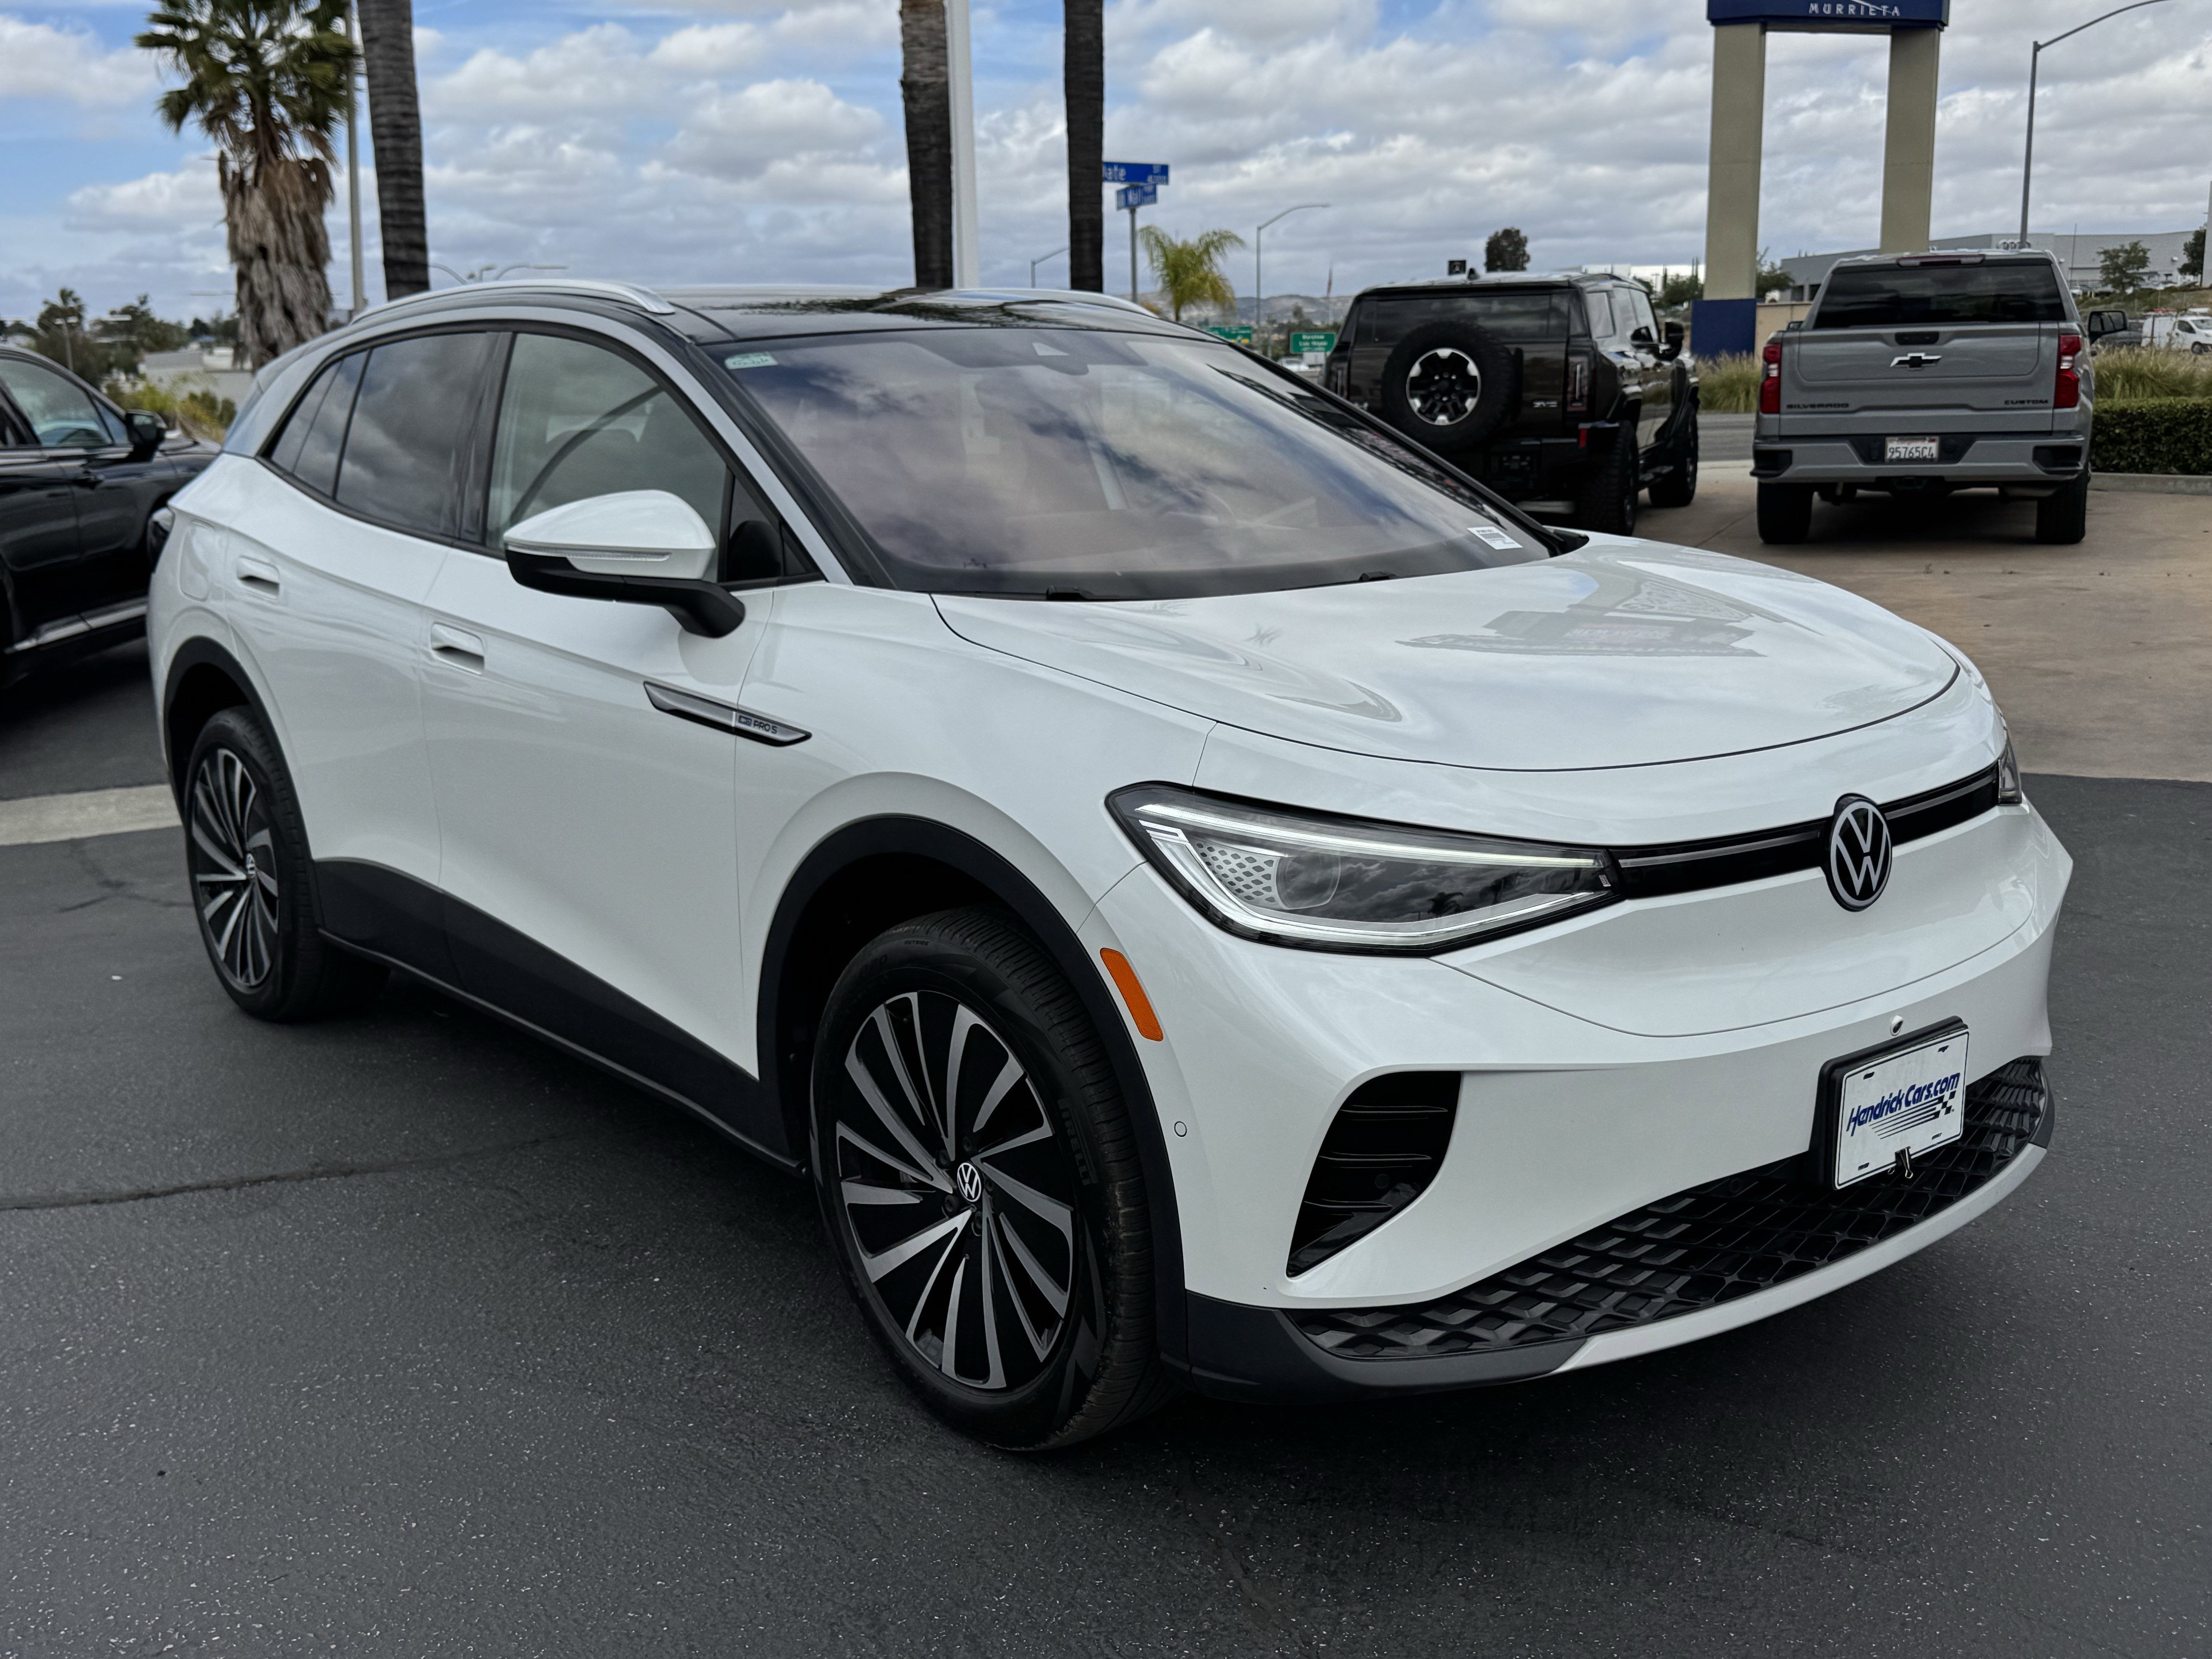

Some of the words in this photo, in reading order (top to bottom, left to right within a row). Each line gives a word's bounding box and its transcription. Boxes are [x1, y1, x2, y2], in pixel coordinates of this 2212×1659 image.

[1808, 3, 1900, 17] MURRIETA
[754, 720, 771, 732] PRO
[771, 725, 778, 734] S
